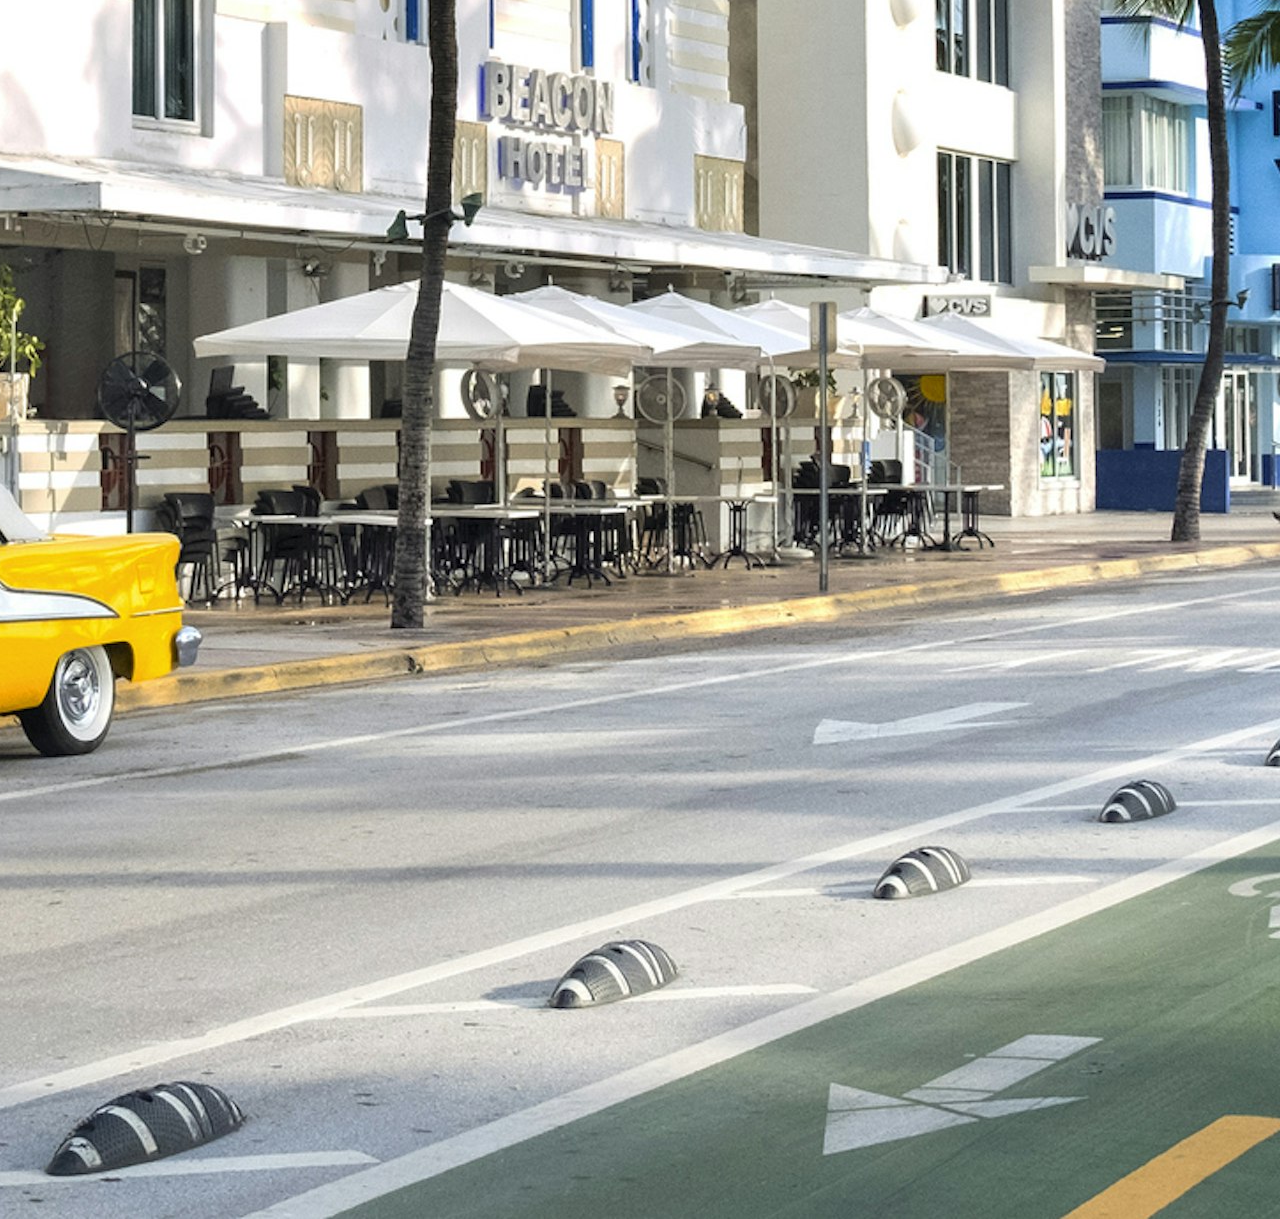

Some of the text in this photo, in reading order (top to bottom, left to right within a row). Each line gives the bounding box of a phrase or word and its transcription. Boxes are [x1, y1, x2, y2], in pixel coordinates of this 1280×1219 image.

[483, 62, 614, 134] BEACON
[498, 135, 594, 188] HOTEL
[1080, 203, 1117, 257] CVS
[950, 296, 988, 315] CVS
